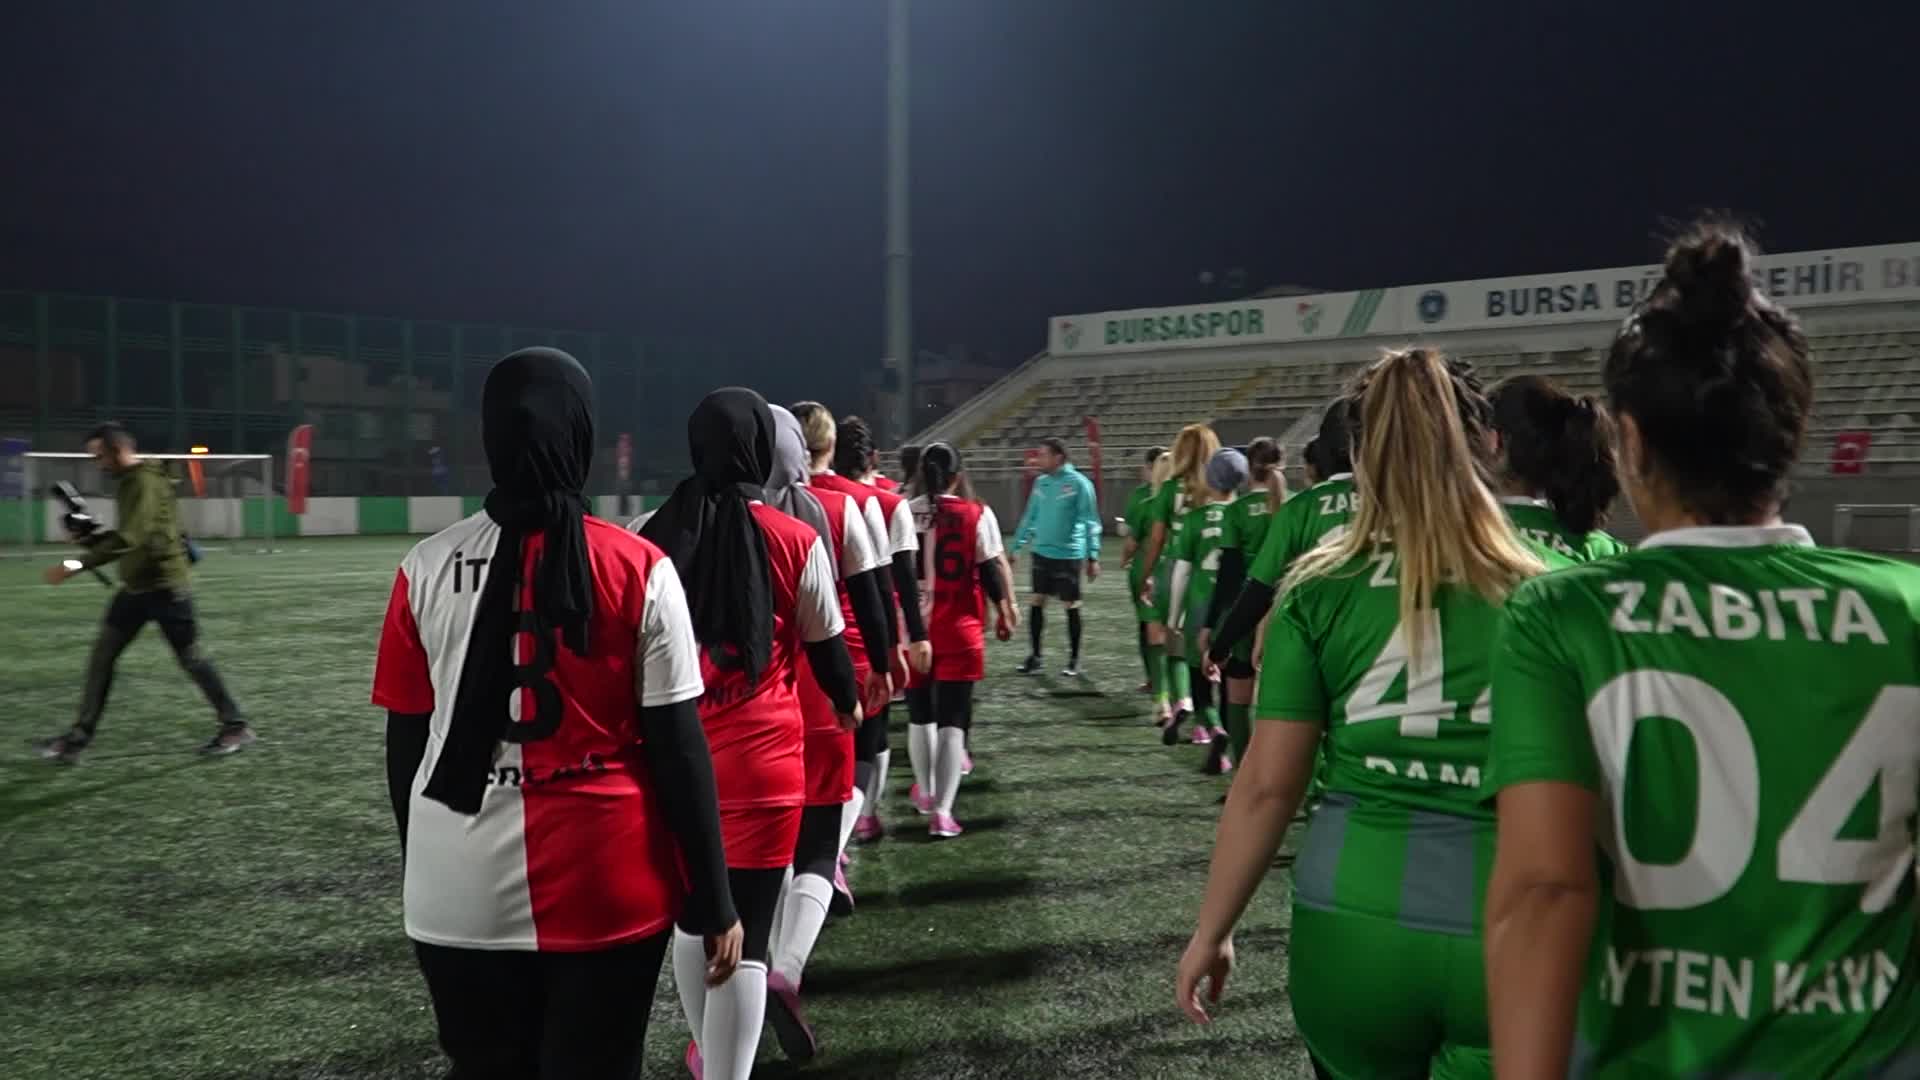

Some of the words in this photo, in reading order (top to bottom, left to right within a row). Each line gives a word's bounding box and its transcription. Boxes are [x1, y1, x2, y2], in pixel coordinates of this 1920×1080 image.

[1487, 283, 1602, 318] BURSA
[1104, 309, 1264, 345] BURSASPOR
[1604, 580, 1889, 645] ZABITA
[1587, 668, 1920, 915] 04
